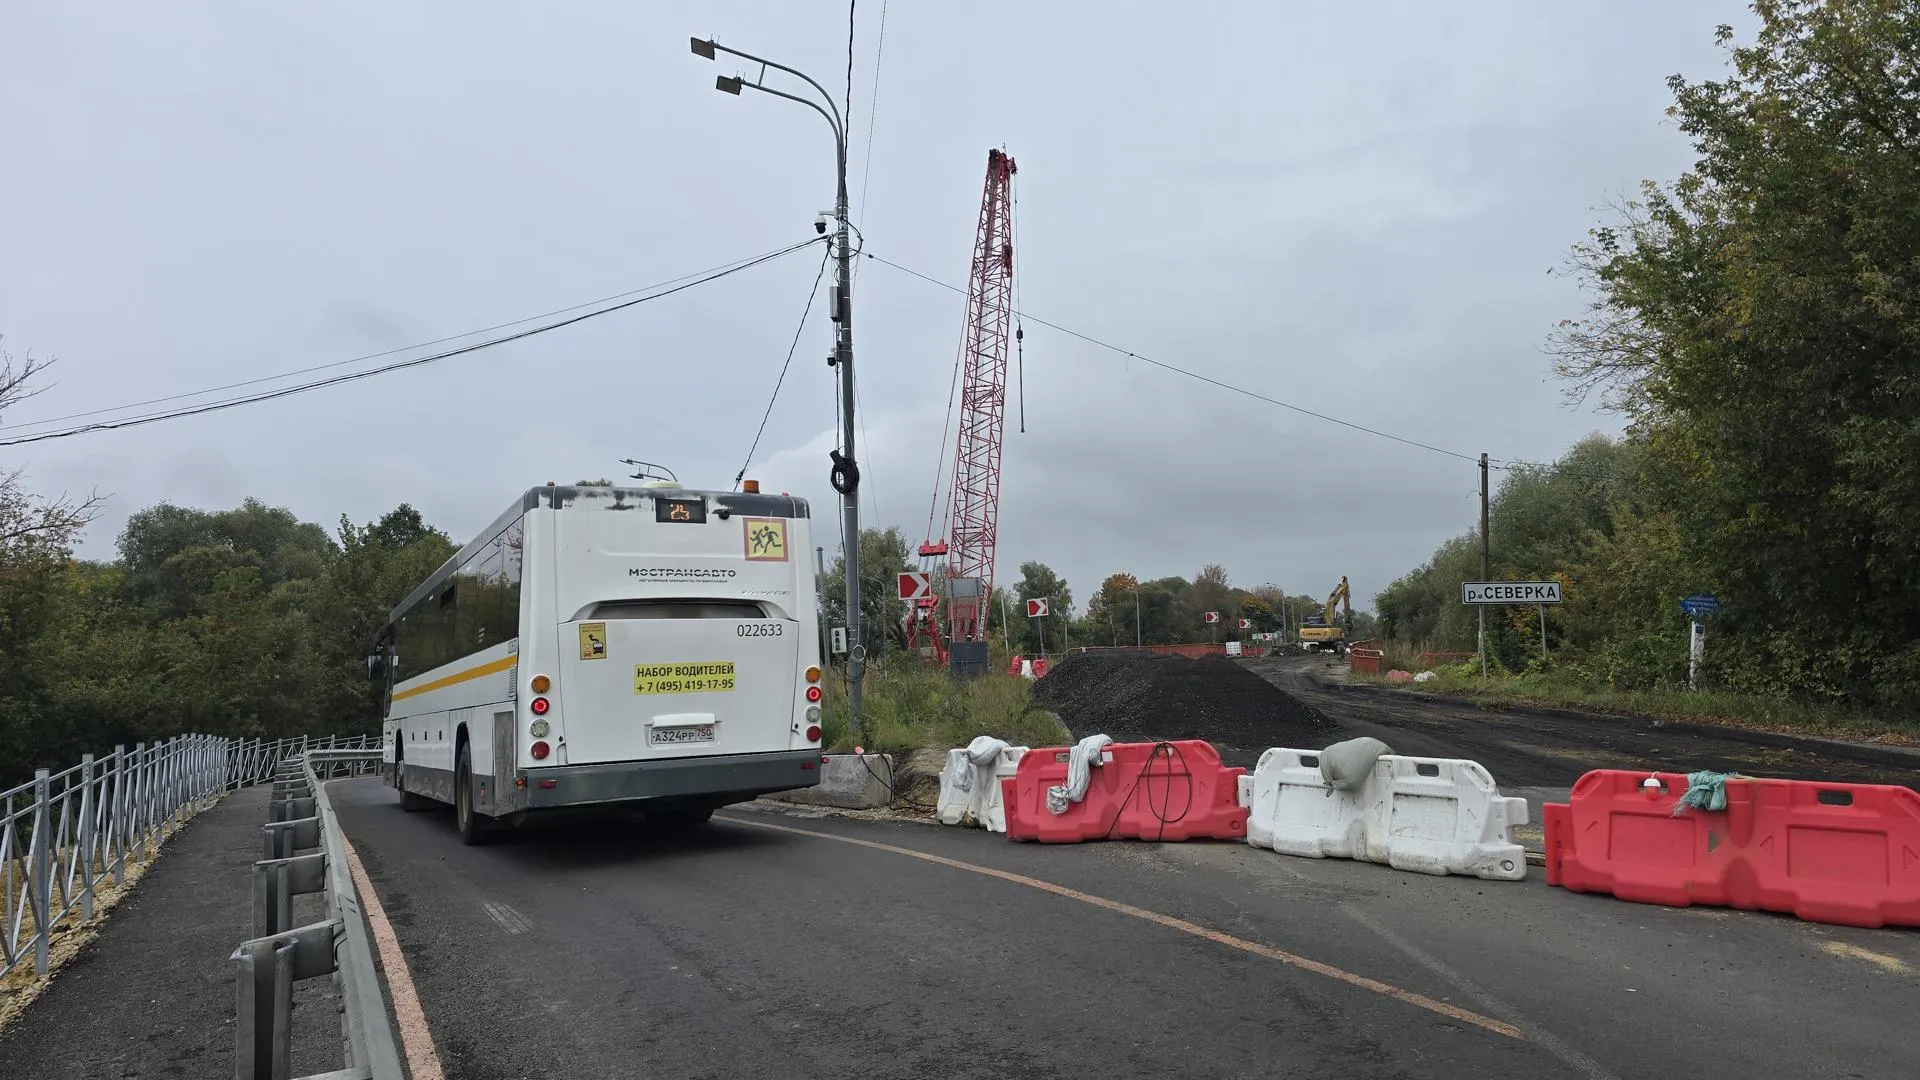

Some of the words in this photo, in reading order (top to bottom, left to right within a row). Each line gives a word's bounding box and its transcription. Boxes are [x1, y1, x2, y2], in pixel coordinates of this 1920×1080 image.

[628, 568, 736, 578] МОСТРАНСАВТО
[737, 624, 783, 637] 022633
[637, 667, 673, 677] НАБОР
[675, 663, 734, 677] ВОДИТЕЛЕЙ
[656, 681, 682, 693] (495)
[684, 679, 734, 690] 419-17-95
